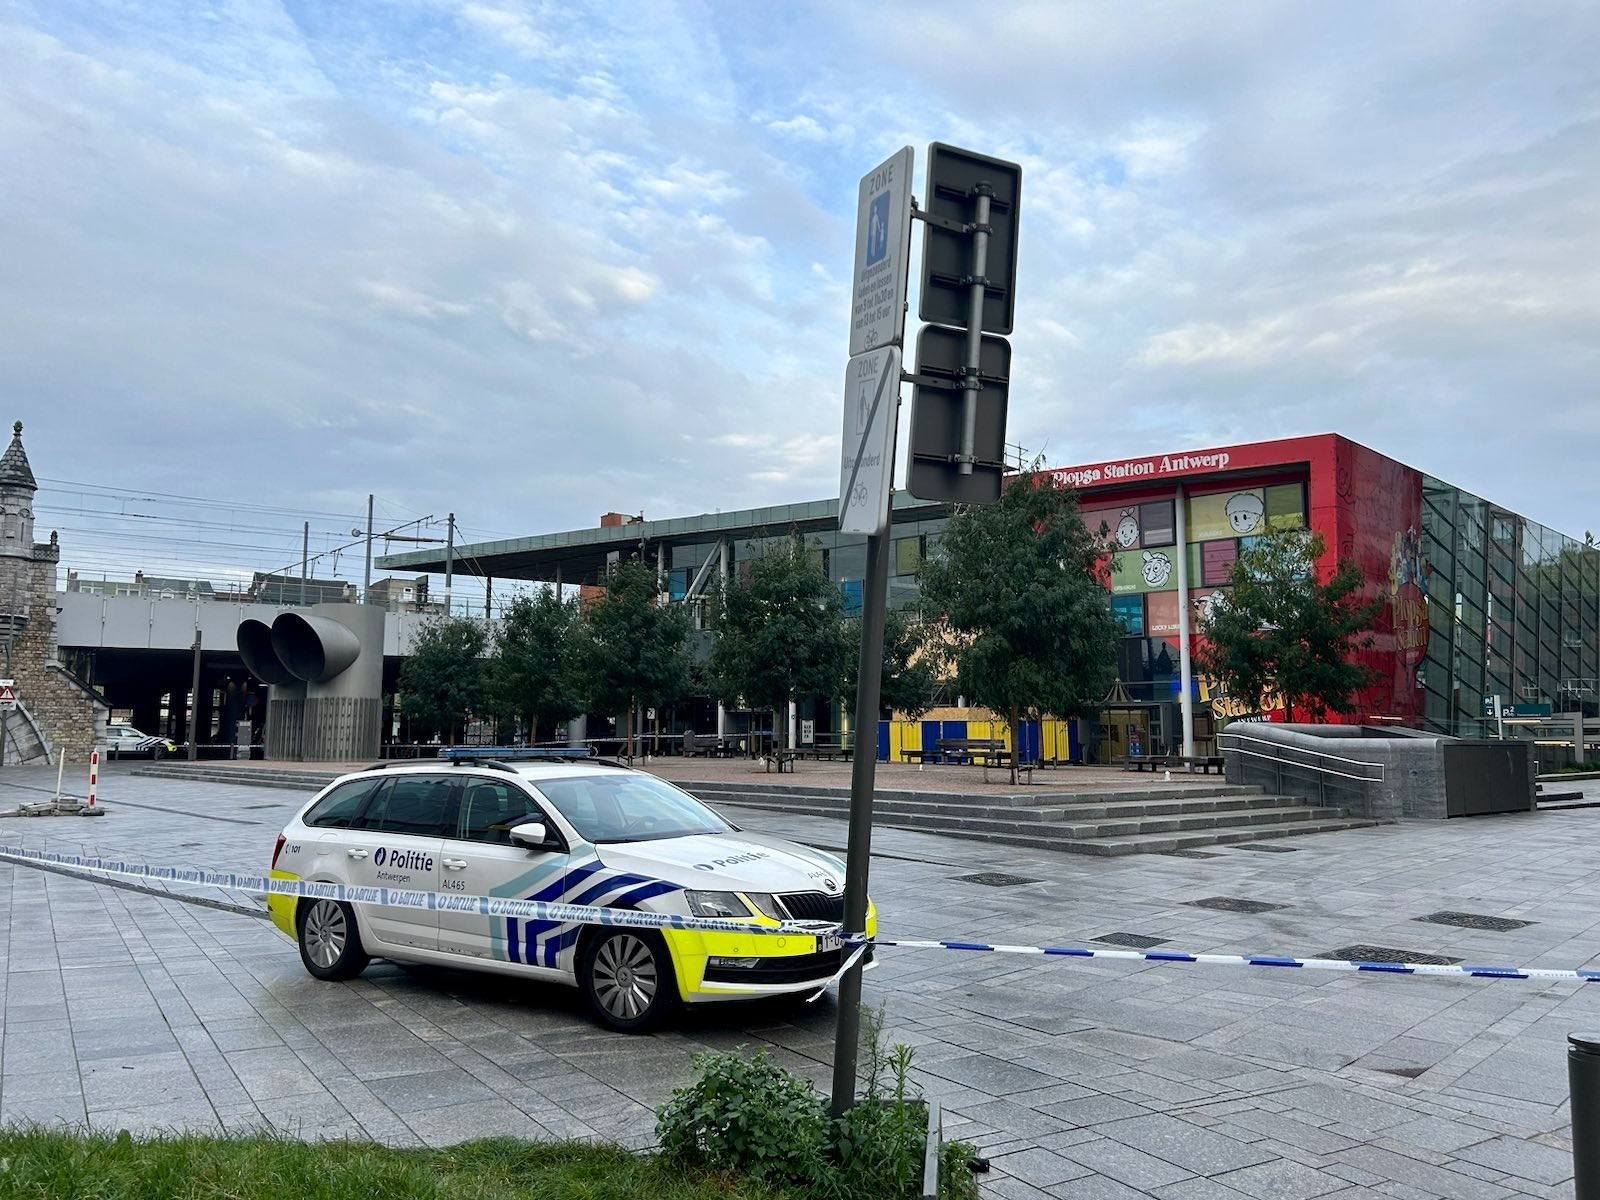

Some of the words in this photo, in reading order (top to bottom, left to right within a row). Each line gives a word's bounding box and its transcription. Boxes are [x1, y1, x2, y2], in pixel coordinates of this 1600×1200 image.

[869, 164, 895, 195] ZONE
[857, 356, 879, 377] ZONE
[1051, 469, 1101, 489] Plopsa
[1103, 460, 1154, 480] Station
[1159, 451, 1230, 474] Antwerp
[389, 850, 433, 872] Politie
[712, 852, 771, 868] Politie
[377, 871, 411, 884] Antwerpen
[442, 879, 466, 891] AL465
